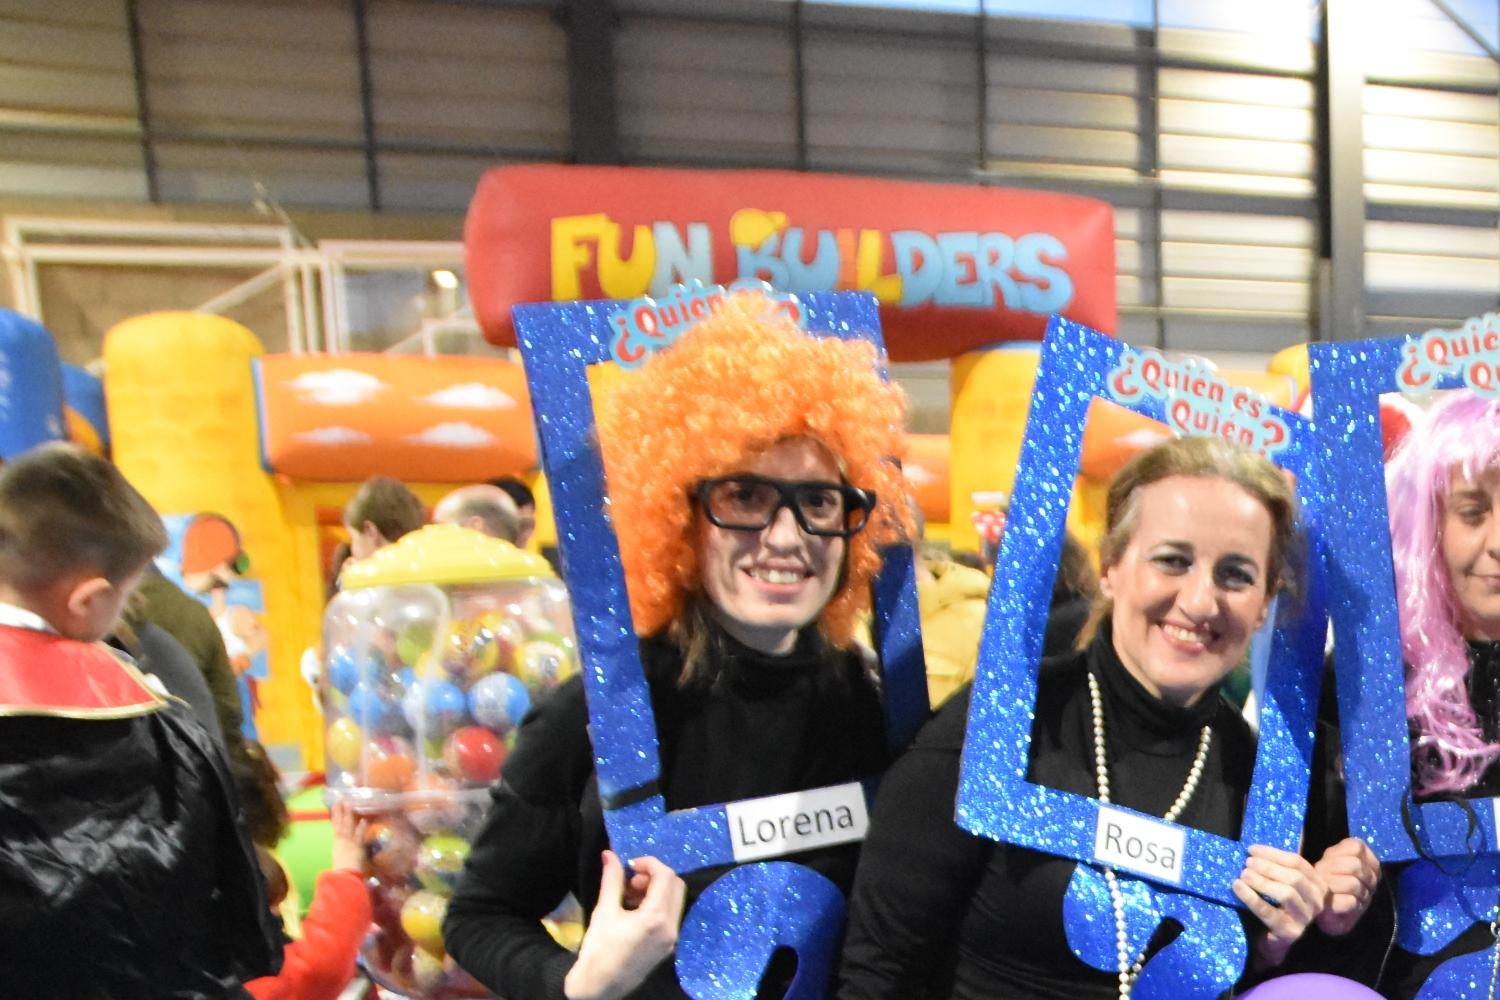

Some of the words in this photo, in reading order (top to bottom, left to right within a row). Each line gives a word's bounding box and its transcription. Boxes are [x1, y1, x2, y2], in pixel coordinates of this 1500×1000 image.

[551, 213, 713, 302] FUN
[730, 210, 1074, 313] BUILDERS
[1113, 356, 1225, 402] ¿Quién
[1232, 391, 1263, 419] es
[1171, 398, 1285, 456] Quién?
[738, 804, 855, 847] Lorena
[1104, 822, 1176, 870] Rosa
